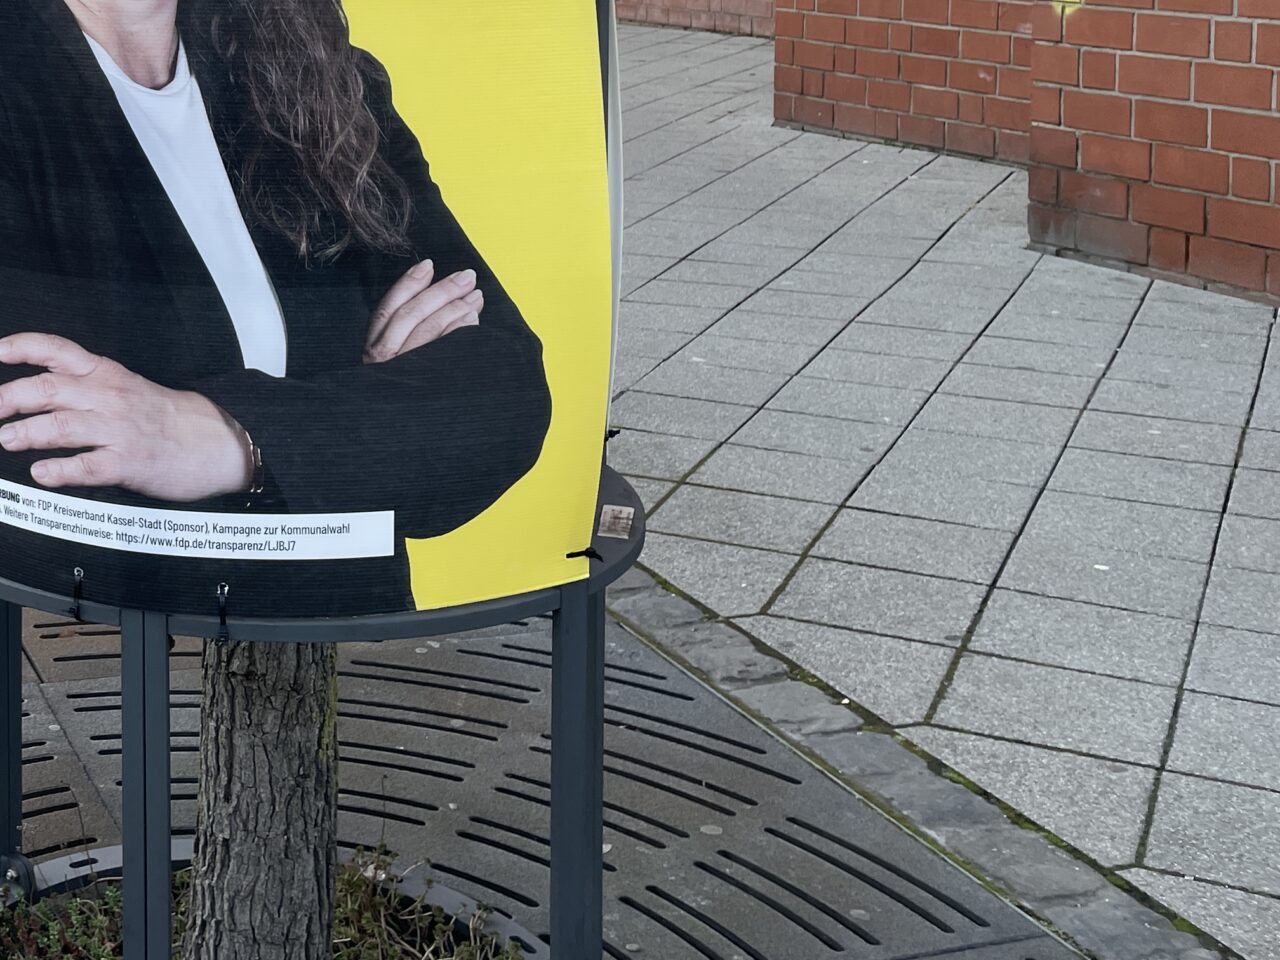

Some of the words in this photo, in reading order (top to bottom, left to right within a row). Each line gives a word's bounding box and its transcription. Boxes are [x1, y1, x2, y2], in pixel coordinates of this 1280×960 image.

[3, 504, 29, 522] Weitere
[30, 512, 114, 541] Transparenzhinweise:
[22, 497, 36, 508] von:
[37, 499, 52, 511] FDP
[53, 503, 105, 523] Kreisverband
[107, 513, 162, 530] Kassel-Stadt
[212, 522, 261, 537] Kampagne
[264, 526, 278, 535] zur
[280, 523, 350, 536] Kommunalwahl
